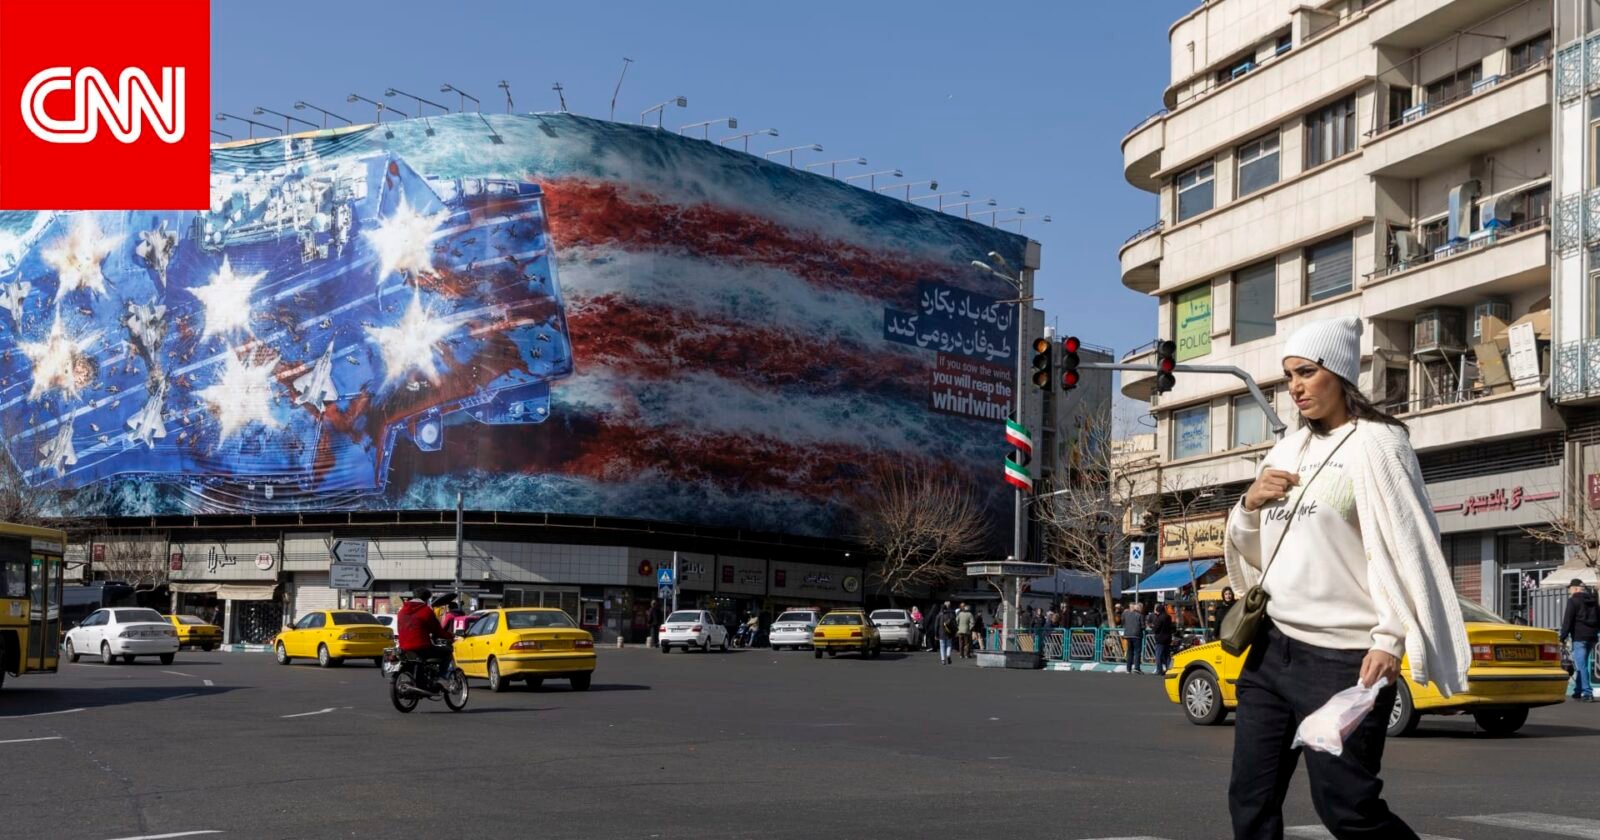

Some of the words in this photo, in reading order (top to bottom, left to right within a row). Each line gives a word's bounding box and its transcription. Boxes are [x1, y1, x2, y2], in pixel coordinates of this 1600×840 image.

[921, 288, 955, 319] بکارد
[958, 295, 980, 325] باد
[961, 329, 1012, 361] طوفان
[939, 355, 946, 366] If
[947, 359, 961, 370] you
[963, 363, 978, 374] sow
[980, 365, 992, 377] the
[933, 371, 953, 386] you
[954, 374, 971, 390] will
[972, 379, 994, 397] reap
[995, 382, 1012, 397] the
[932, 388, 1011, 420] whirlwind
